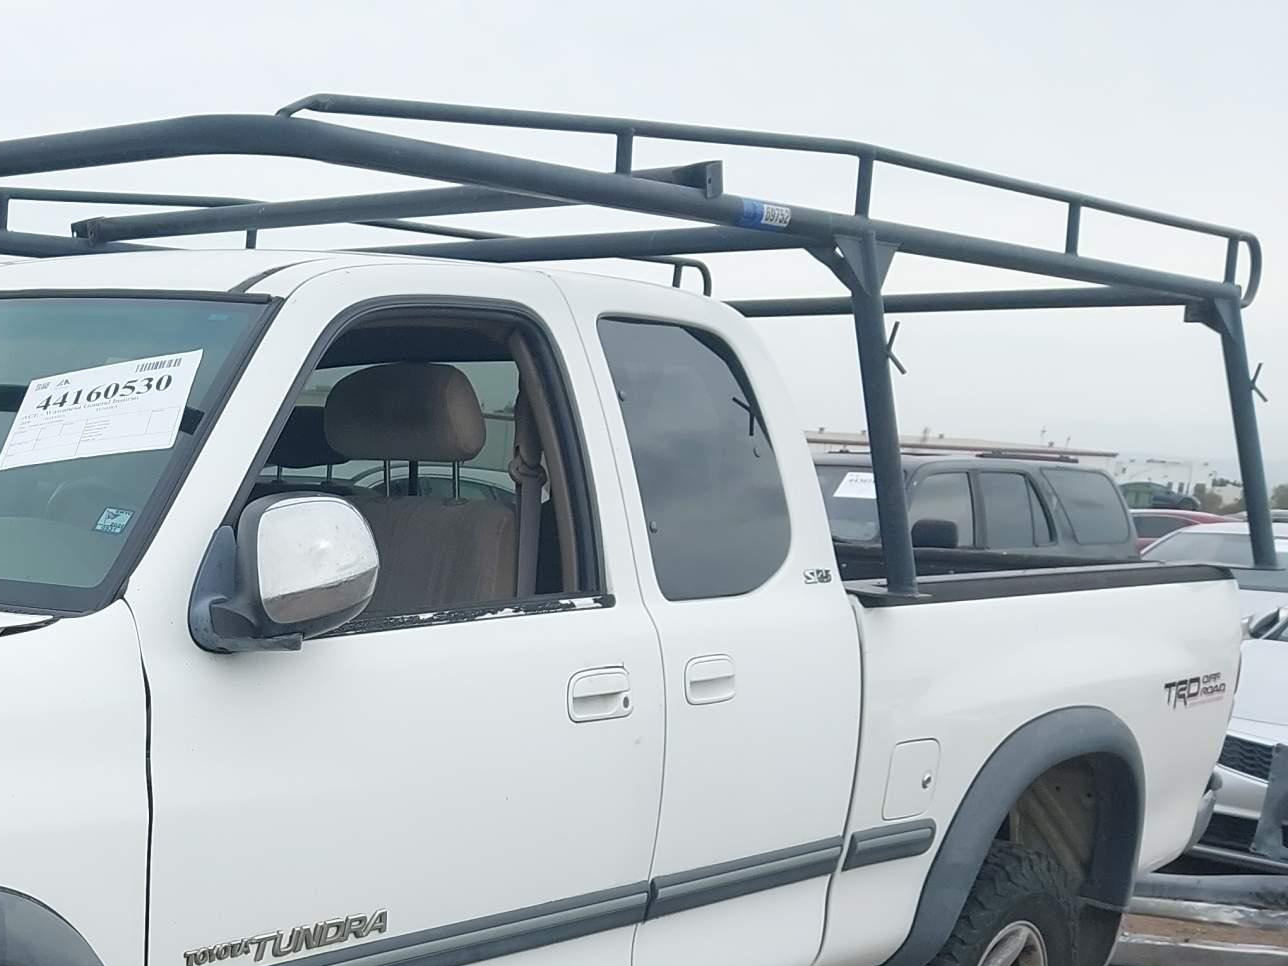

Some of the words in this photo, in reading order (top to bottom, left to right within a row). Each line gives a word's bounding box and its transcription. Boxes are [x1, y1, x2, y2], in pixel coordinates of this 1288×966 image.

[35, 374, 173, 411] 44160530
[1164, 676, 1201, 710] TRD
[1200, 683, 1226, 696] ROAD
[251, 908, 389, 962] TUNDRA
